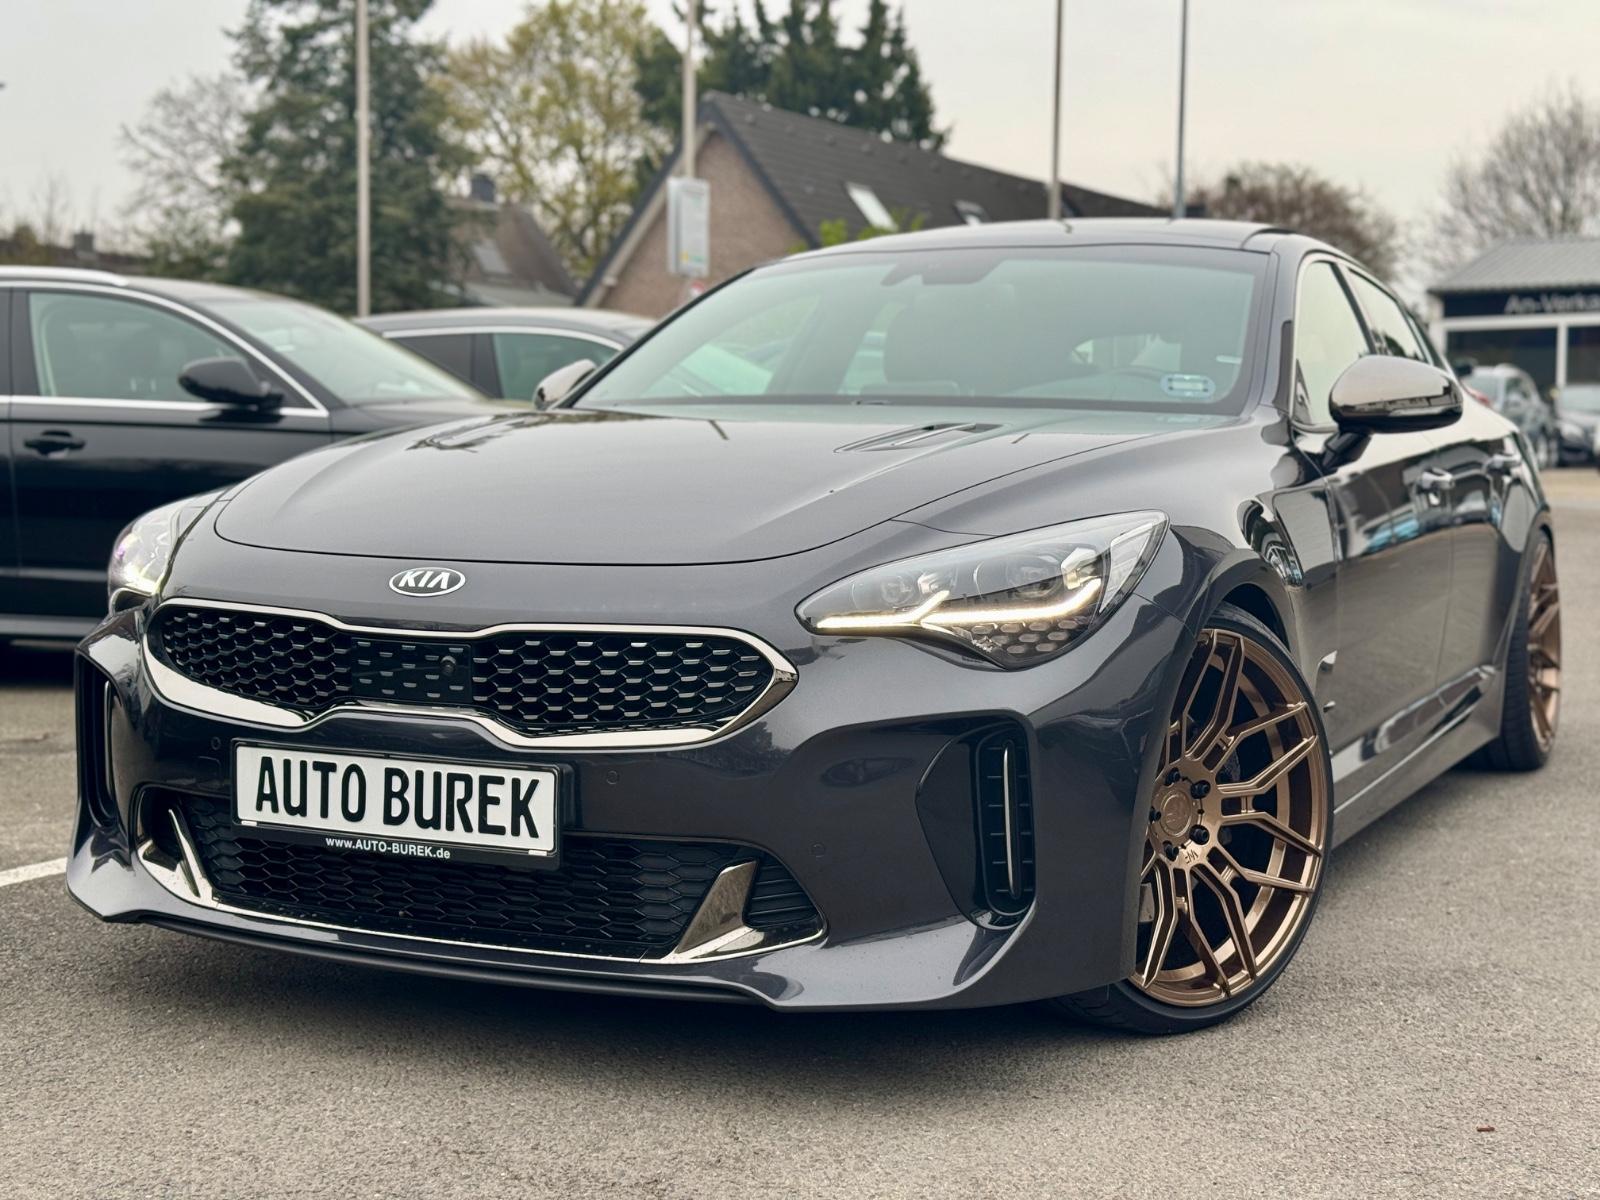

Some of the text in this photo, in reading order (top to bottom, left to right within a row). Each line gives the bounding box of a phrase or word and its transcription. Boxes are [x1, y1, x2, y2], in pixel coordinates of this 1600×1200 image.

[398, 570, 450, 590] KIA
[255, 756, 540, 839] AUTO BUREK
[325, 837, 451, 860] www.AUTO-BUREK.de
